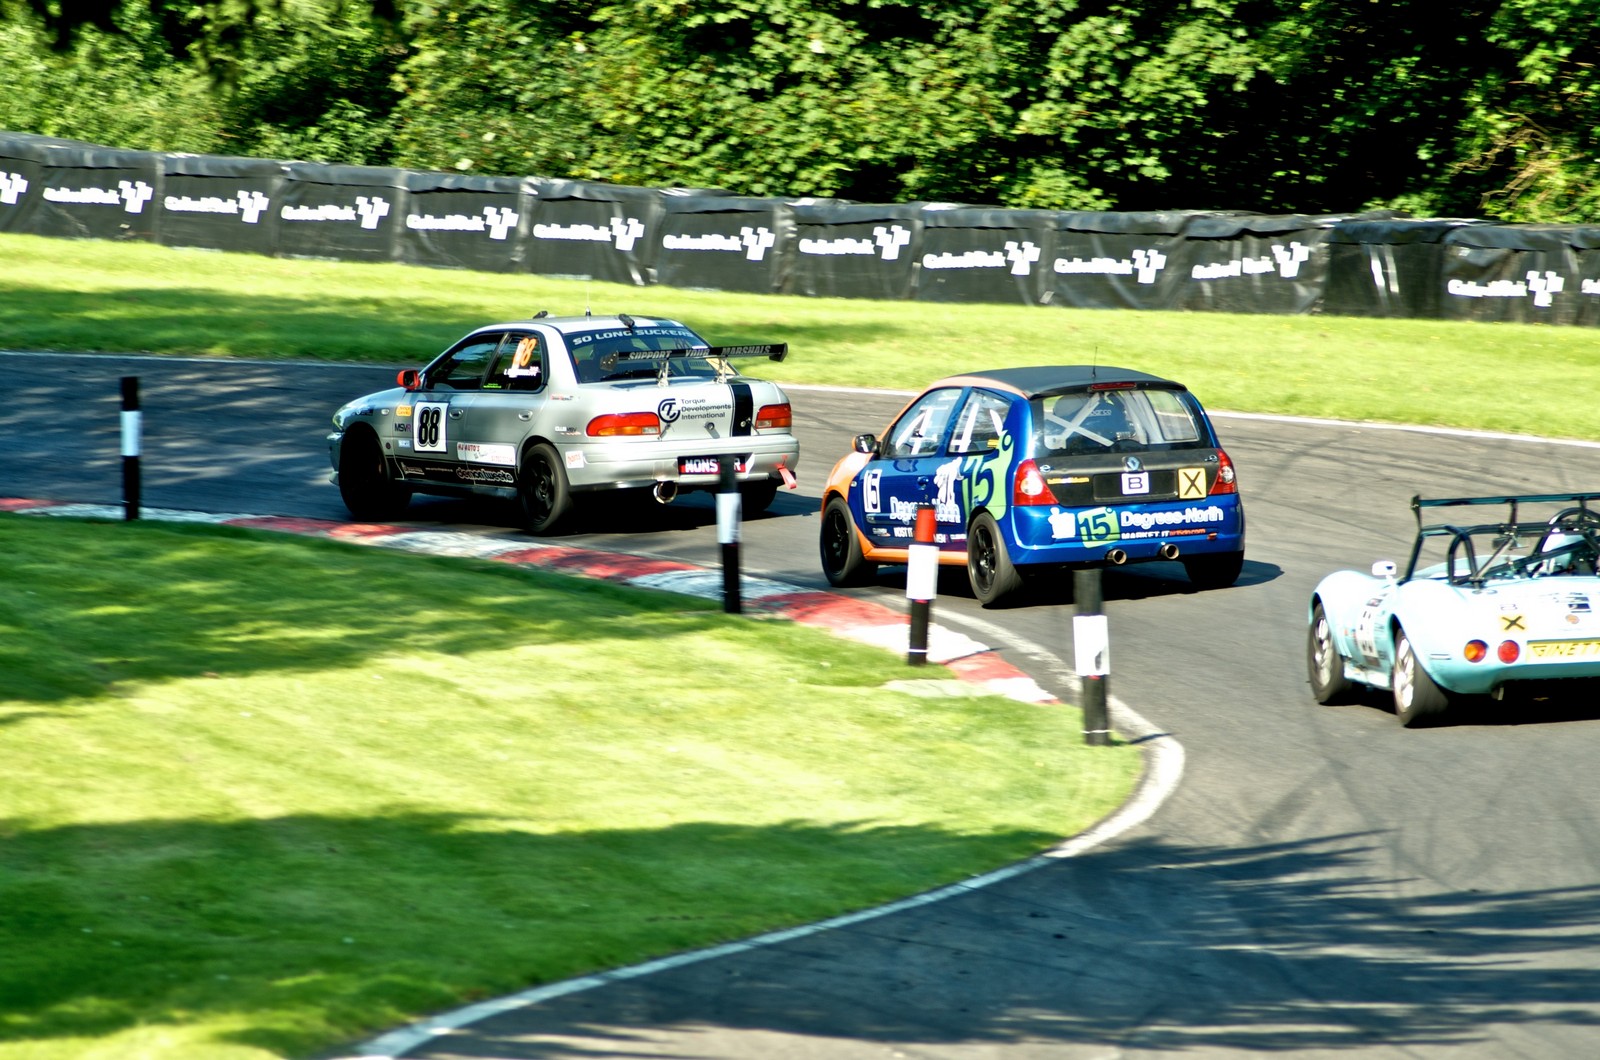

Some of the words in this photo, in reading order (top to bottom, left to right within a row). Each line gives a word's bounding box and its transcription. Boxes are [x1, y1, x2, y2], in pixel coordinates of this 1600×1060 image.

[573, 335, 592, 345] SO
[596, 330, 633, 340] LONG
[636, 329, 695, 338] SUCKERS
[628, 350, 672, 360] SUPPORT
[685, 349, 710, 357] YOUR
[721, 345, 771, 356] MARSHALS
[681, 403, 732, 412] Developments
[681, 412, 726, 420] International
[418, 407, 441, 447] 88
[684, 458, 742, 473] MONSR
[1128, 477, 1143, 490] B
[1183, 471, 1203, 496] X
